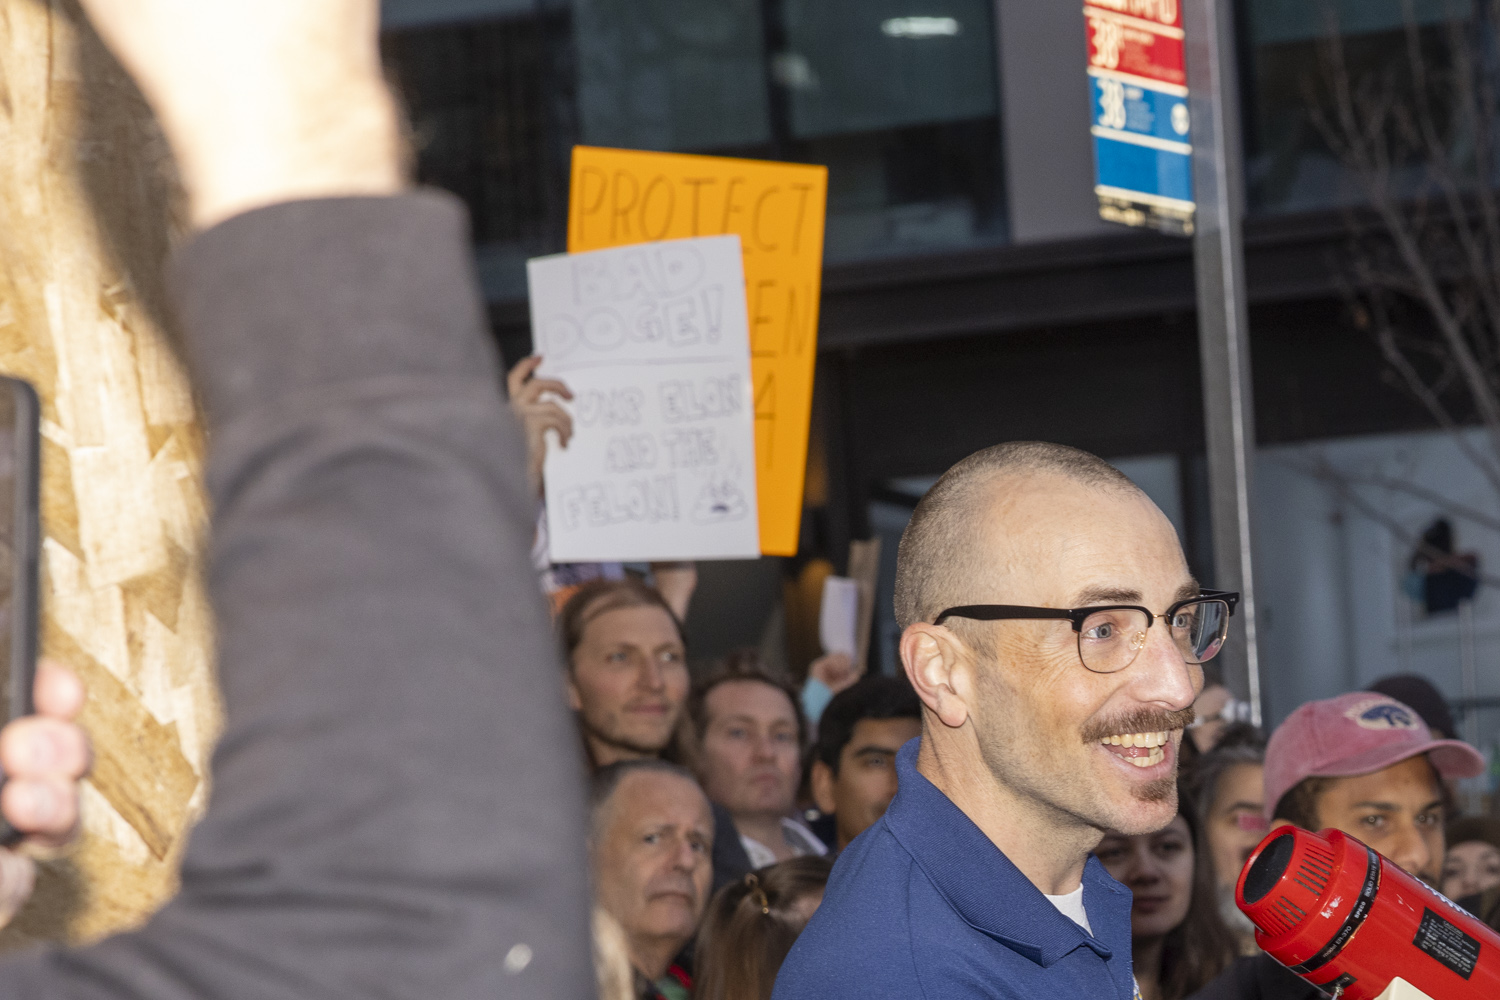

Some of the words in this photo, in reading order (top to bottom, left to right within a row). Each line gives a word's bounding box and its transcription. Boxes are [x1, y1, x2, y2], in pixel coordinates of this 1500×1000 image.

[577, 165, 816, 256] PROTECT
[570, 243, 705, 306] BAD
[657, 373, 742, 424] ELON
